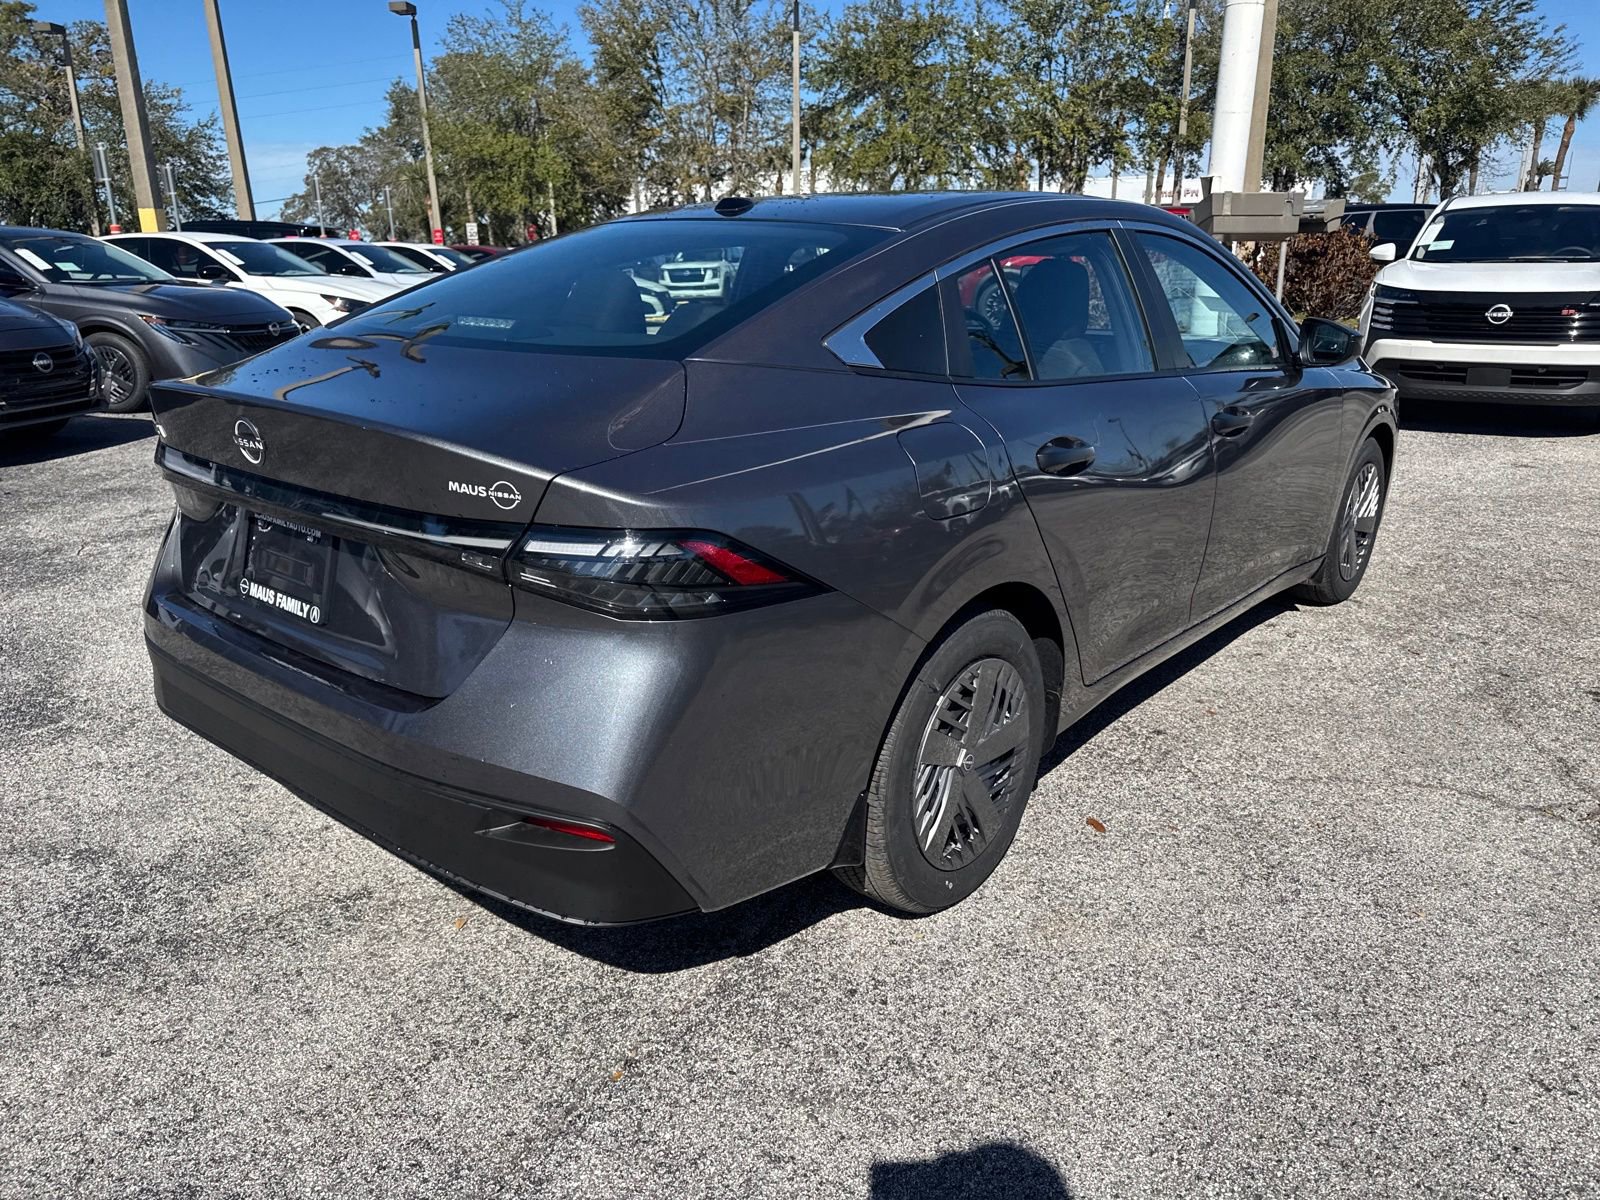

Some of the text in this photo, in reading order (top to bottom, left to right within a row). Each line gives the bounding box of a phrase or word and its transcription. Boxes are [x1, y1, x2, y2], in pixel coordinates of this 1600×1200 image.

[448, 480, 522, 501] MAUS NISSAN
[249, 582, 310, 619] MAUS FAMILY
